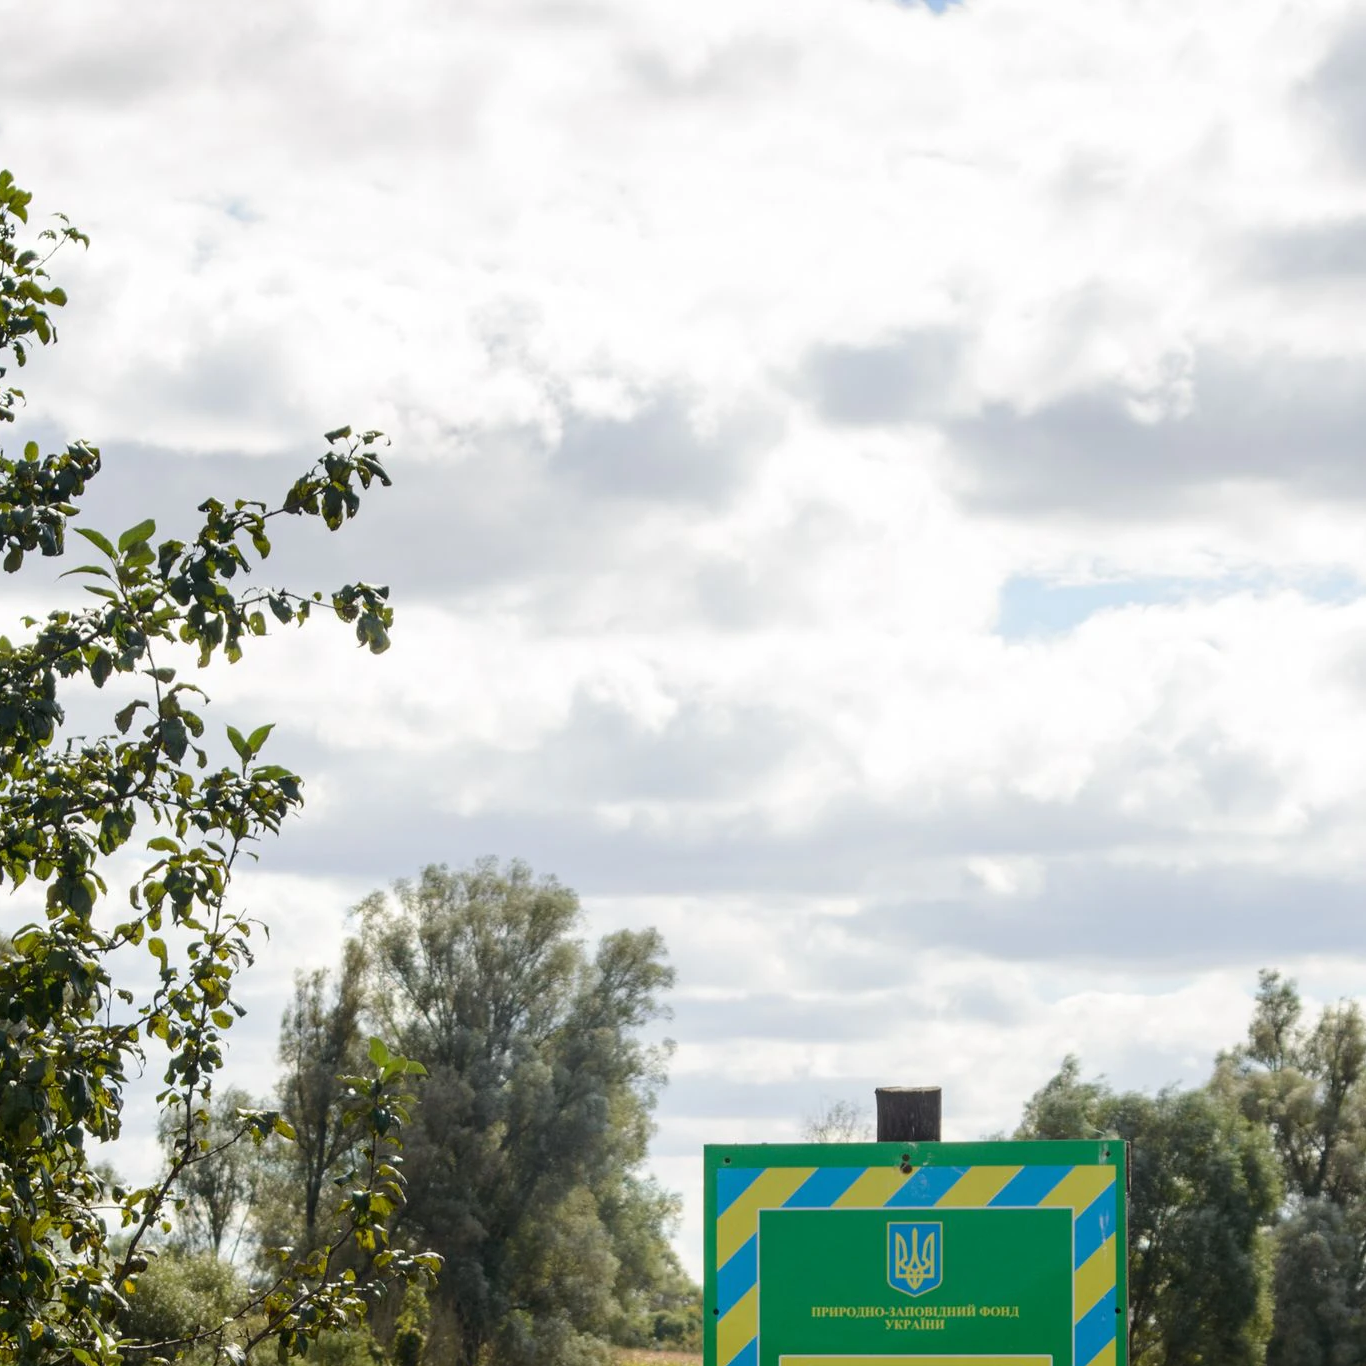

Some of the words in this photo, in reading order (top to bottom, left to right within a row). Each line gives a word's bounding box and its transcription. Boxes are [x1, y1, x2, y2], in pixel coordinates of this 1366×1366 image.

[811, 1304, 976, 1319] ПРИРОДНО-ЗАПОВІДНИЙ
[979, 1306, 1020, 1319] ФОНД
[885, 1319, 946, 1330] УКРАЇНИ
